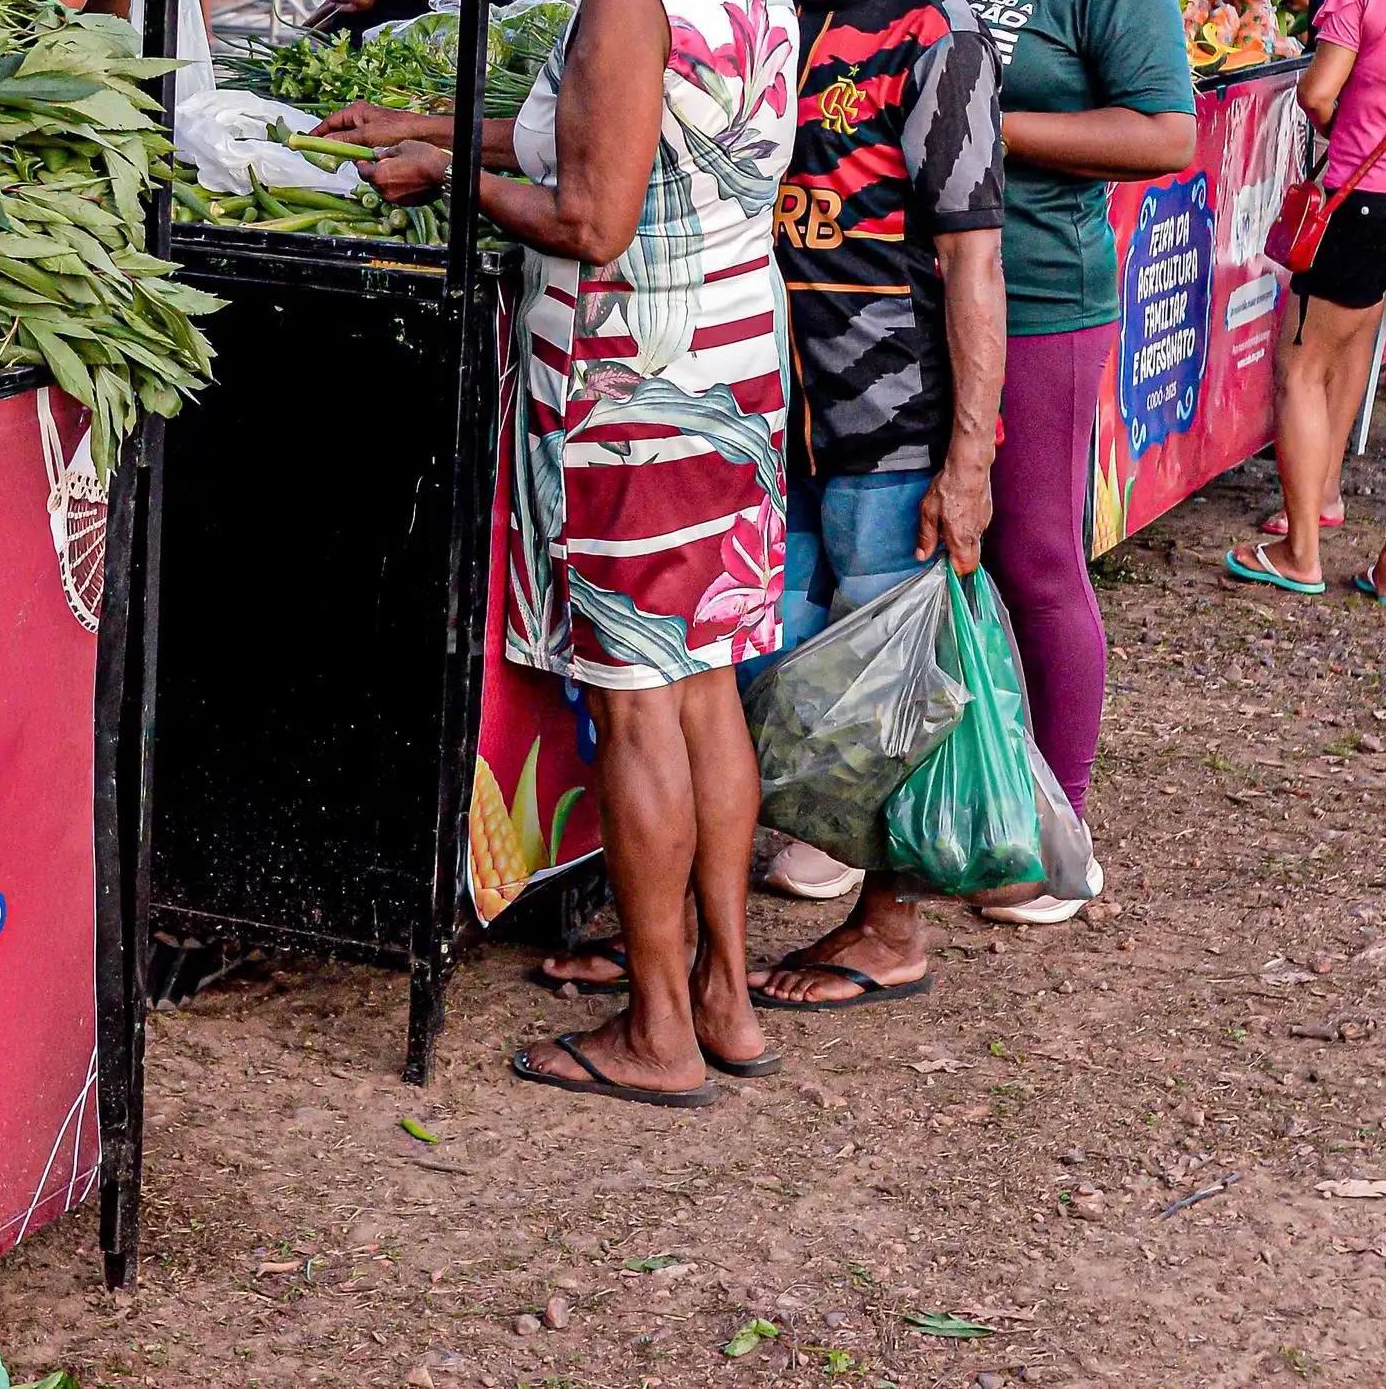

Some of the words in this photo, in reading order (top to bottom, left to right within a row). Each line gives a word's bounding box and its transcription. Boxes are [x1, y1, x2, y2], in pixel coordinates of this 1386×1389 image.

[1149, 215, 1174, 257] FEIRA
[1176, 211, 1190, 246] DA
[1137, 248, 1198, 304] AGRICULTURA
[1144, 290, 1188, 339] FAMILIAR
[1132, 351, 1140, 387] E
[1139, 327, 1195, 382] ARTESANATO
